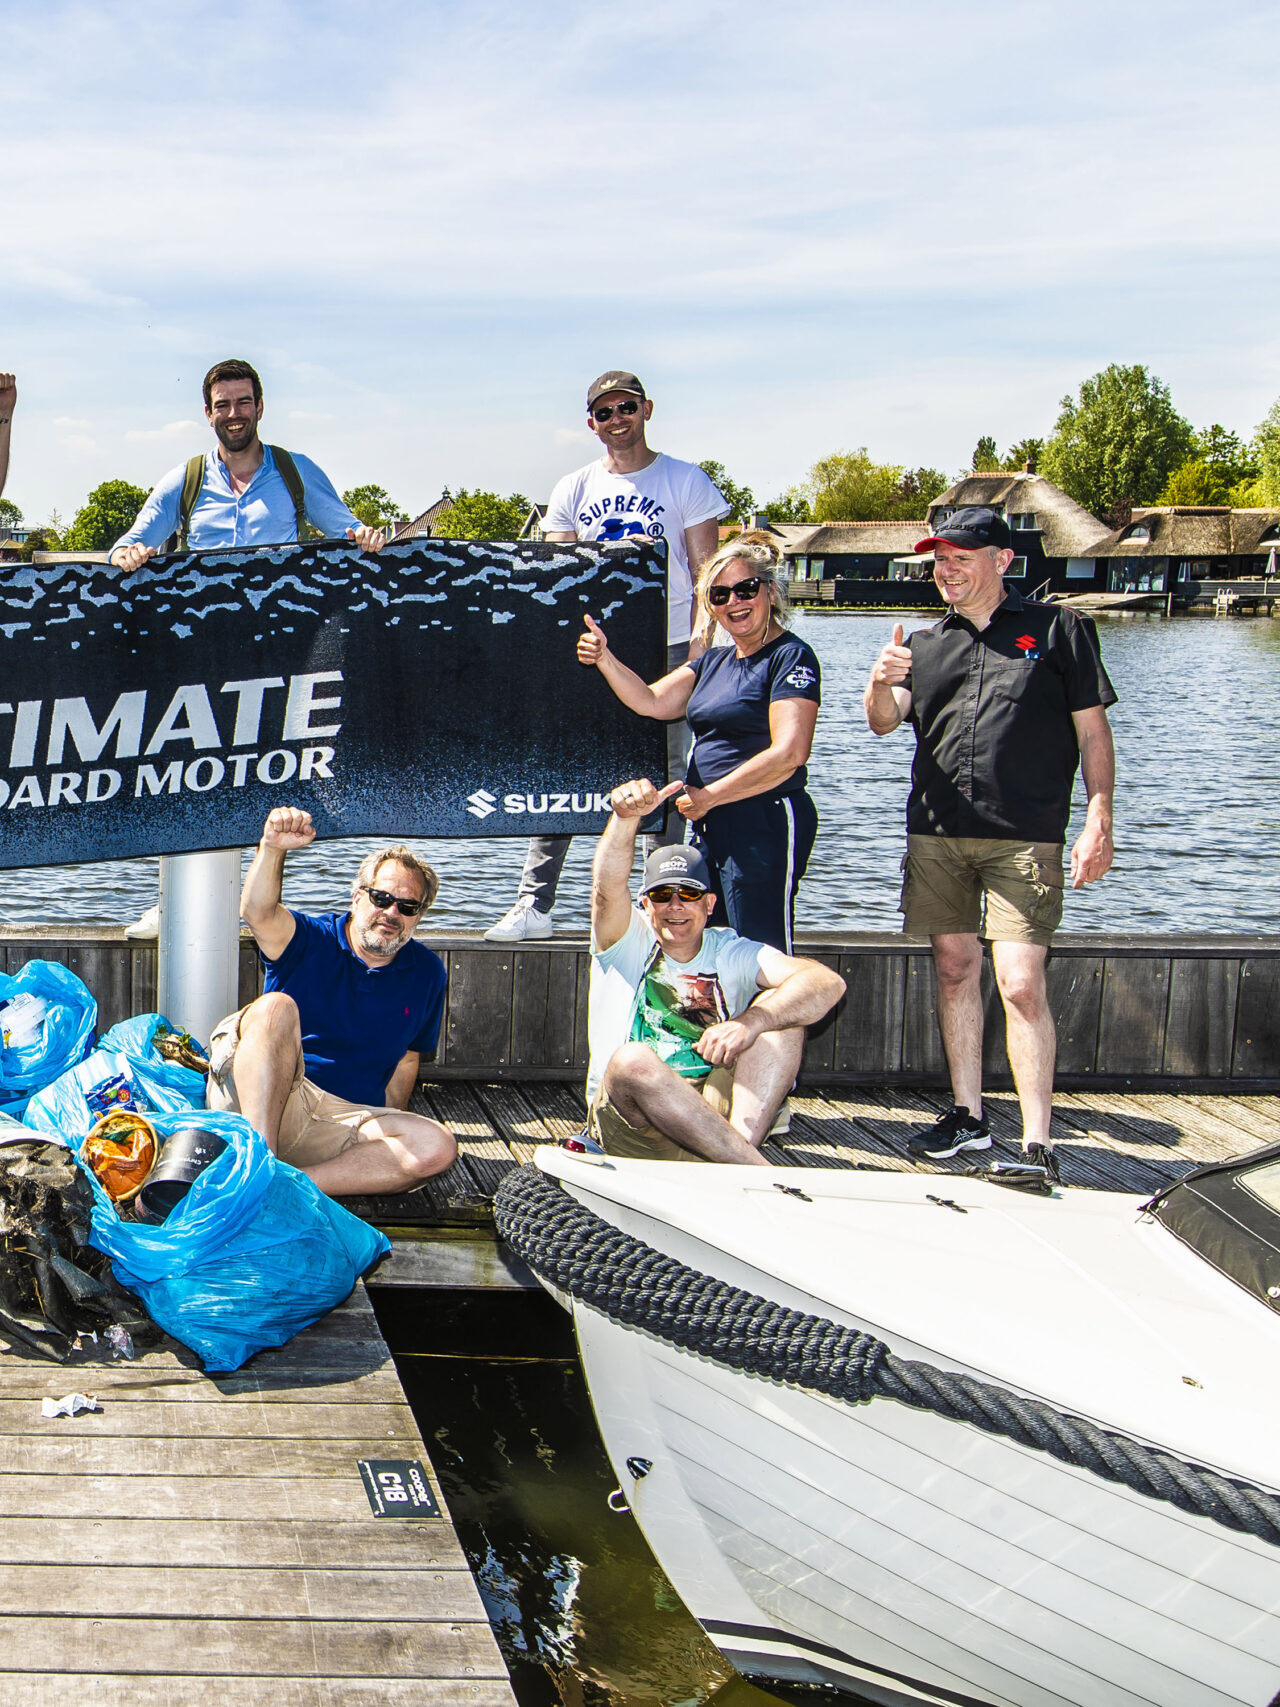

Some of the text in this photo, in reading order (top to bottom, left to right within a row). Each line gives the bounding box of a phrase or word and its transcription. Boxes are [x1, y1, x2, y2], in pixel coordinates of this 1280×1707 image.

[579, 495, 666, 527] SUPREME
[134, 746, 336, 798] MOTOR
[504, 793, 613, 813] SUZUK
[378, 1472, 409, 1502] C18
[408, 1468, 431, 1507] cooper
